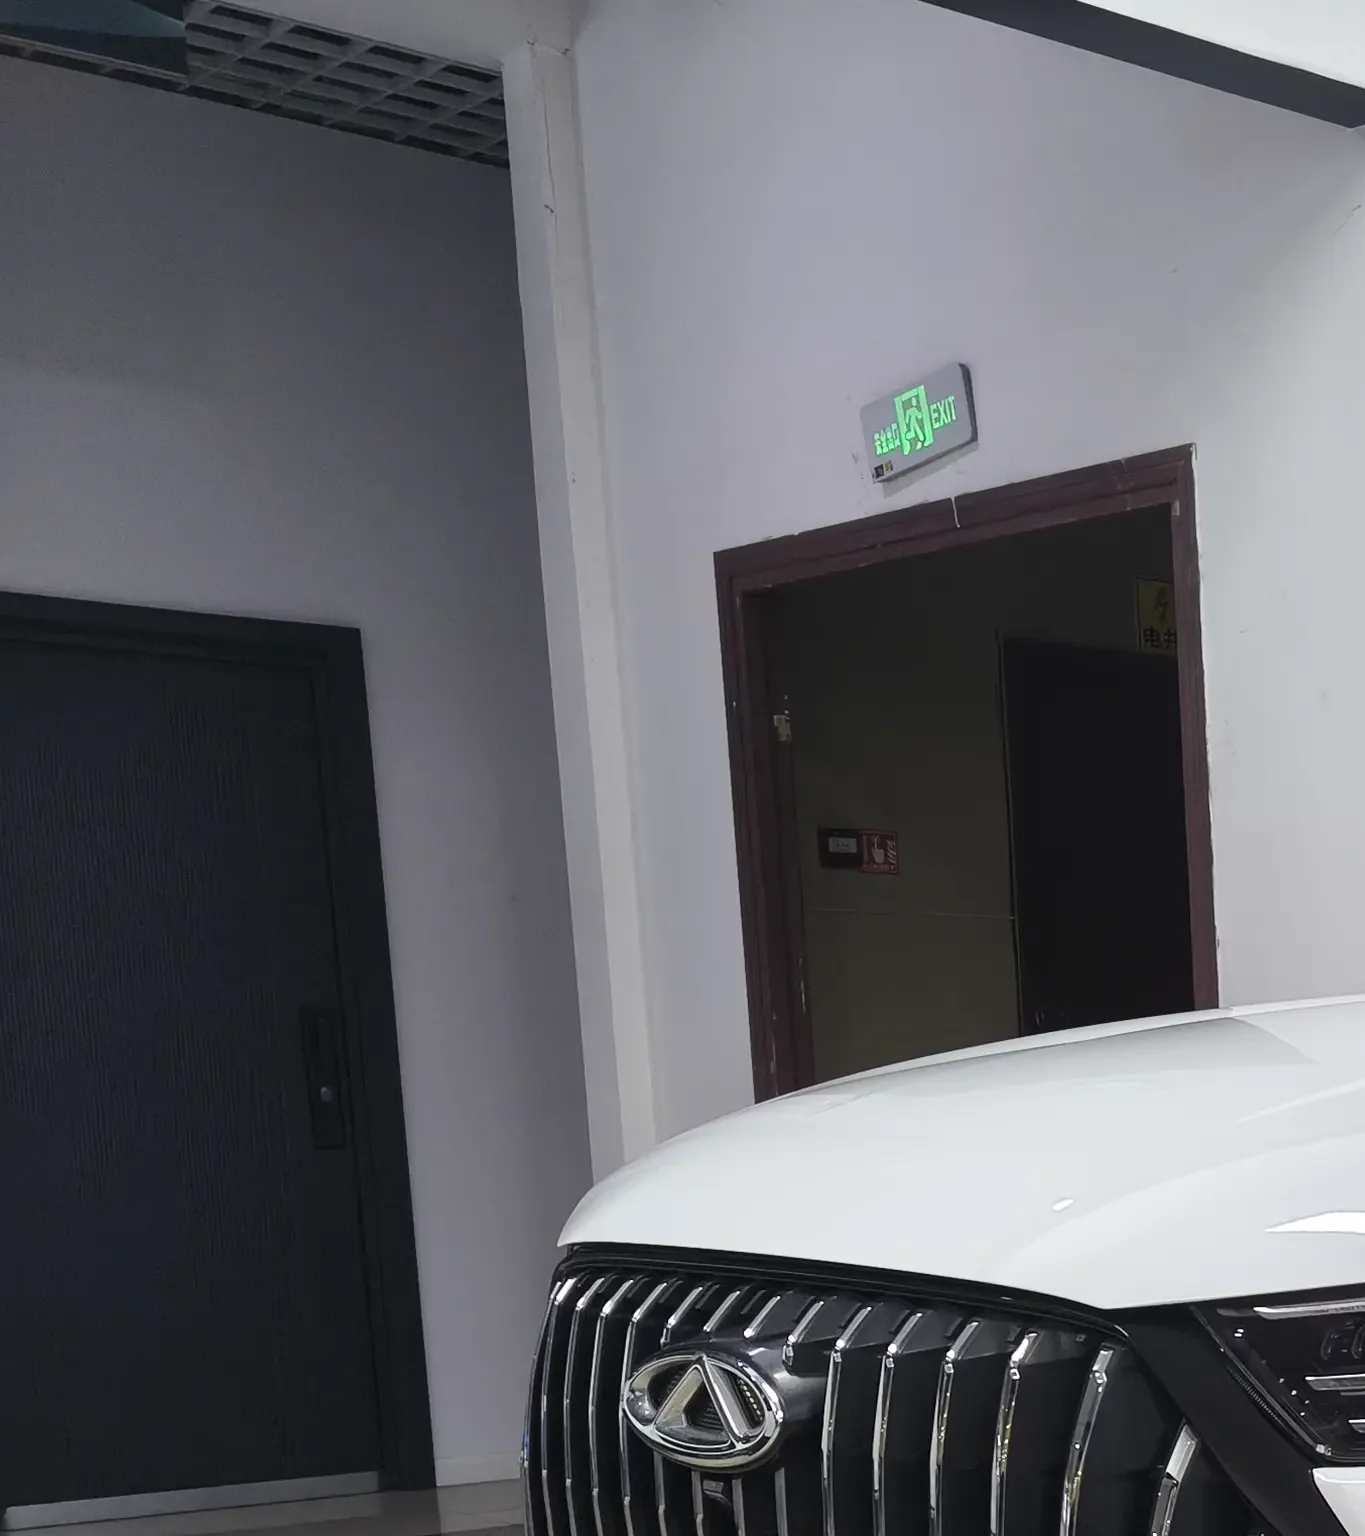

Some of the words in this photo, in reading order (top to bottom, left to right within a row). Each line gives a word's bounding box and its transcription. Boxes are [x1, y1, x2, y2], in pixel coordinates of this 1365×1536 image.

[929, 395, 956, 430] EXIT
[873, 422, 901, 456] 安全出口
